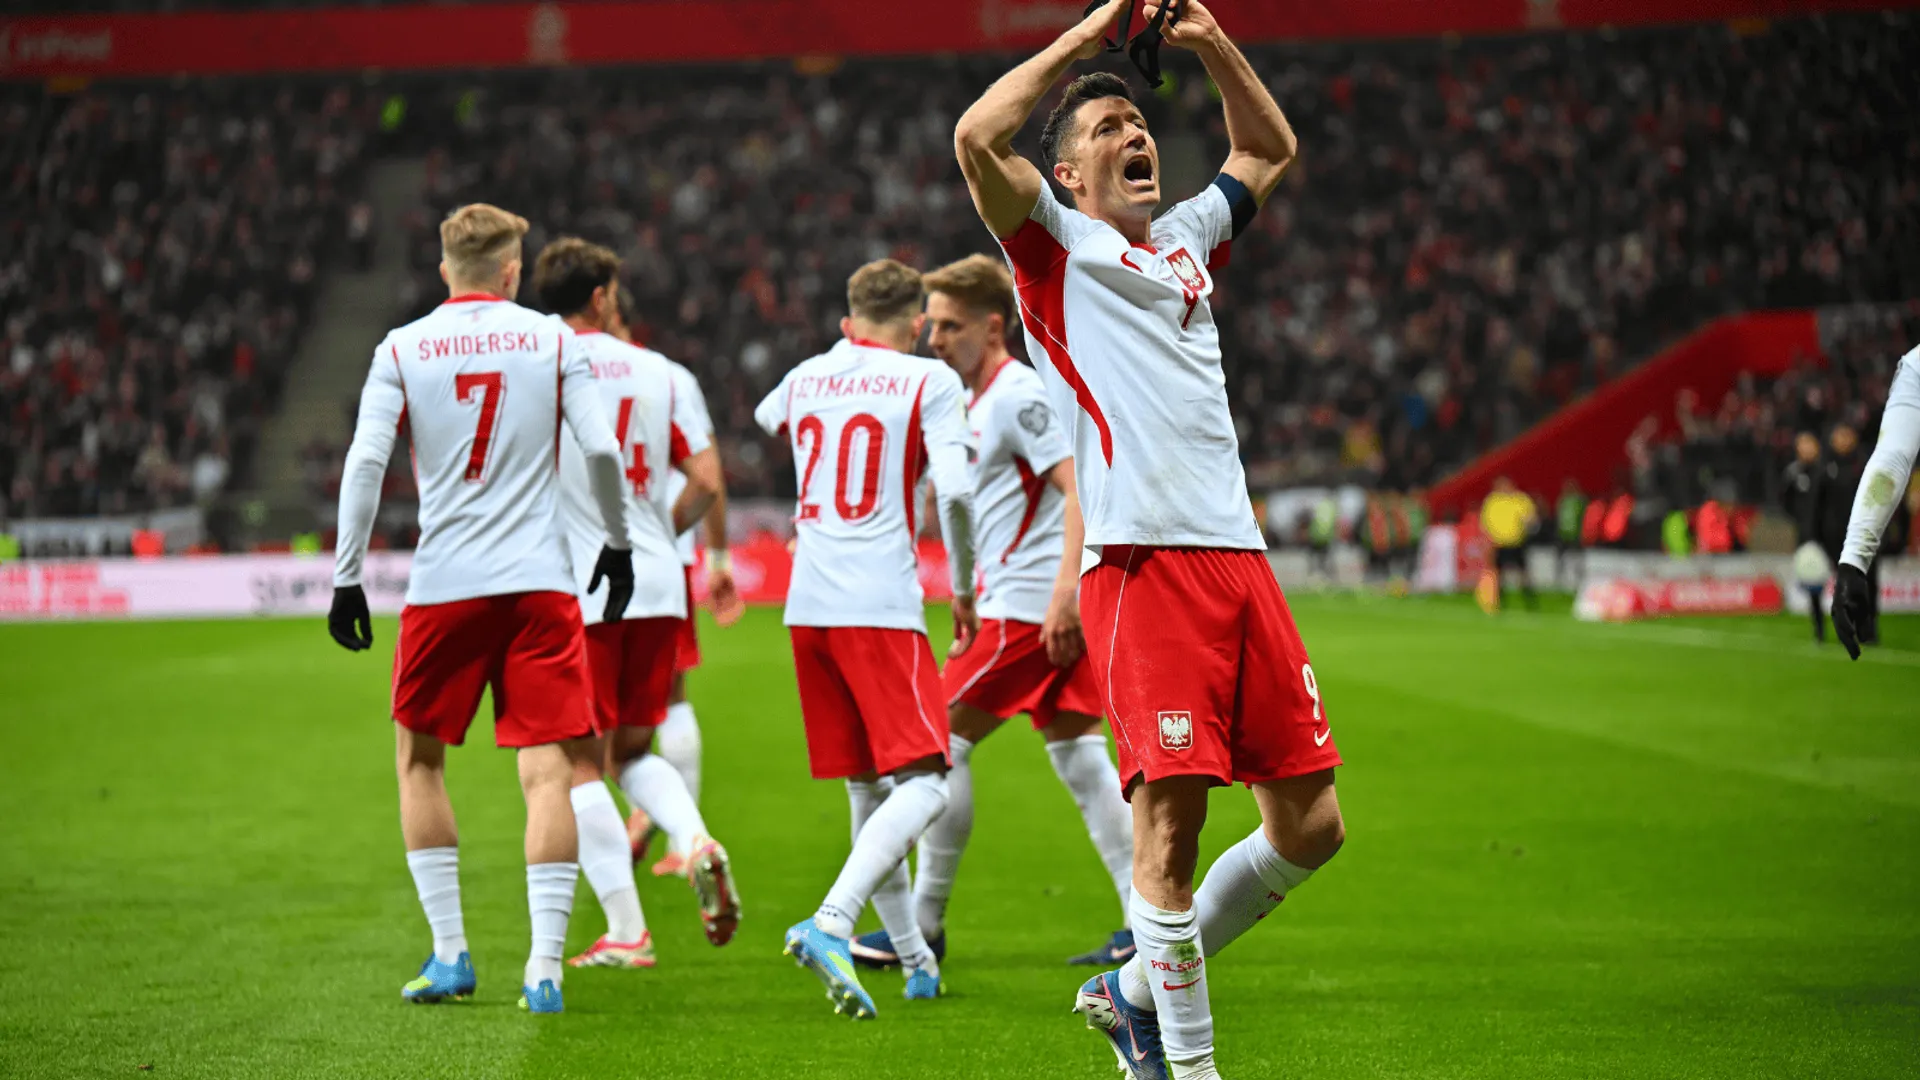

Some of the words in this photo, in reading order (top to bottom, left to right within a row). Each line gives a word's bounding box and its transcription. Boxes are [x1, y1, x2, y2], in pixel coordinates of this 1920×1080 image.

[454, 370, 507, 485] 7
[614, 396, 654, 499] 4
[793, 412, 889, 526] 20
[1302, 663, 1321, 720] 9
[1151, 956, 1203, 973] POLSKA
